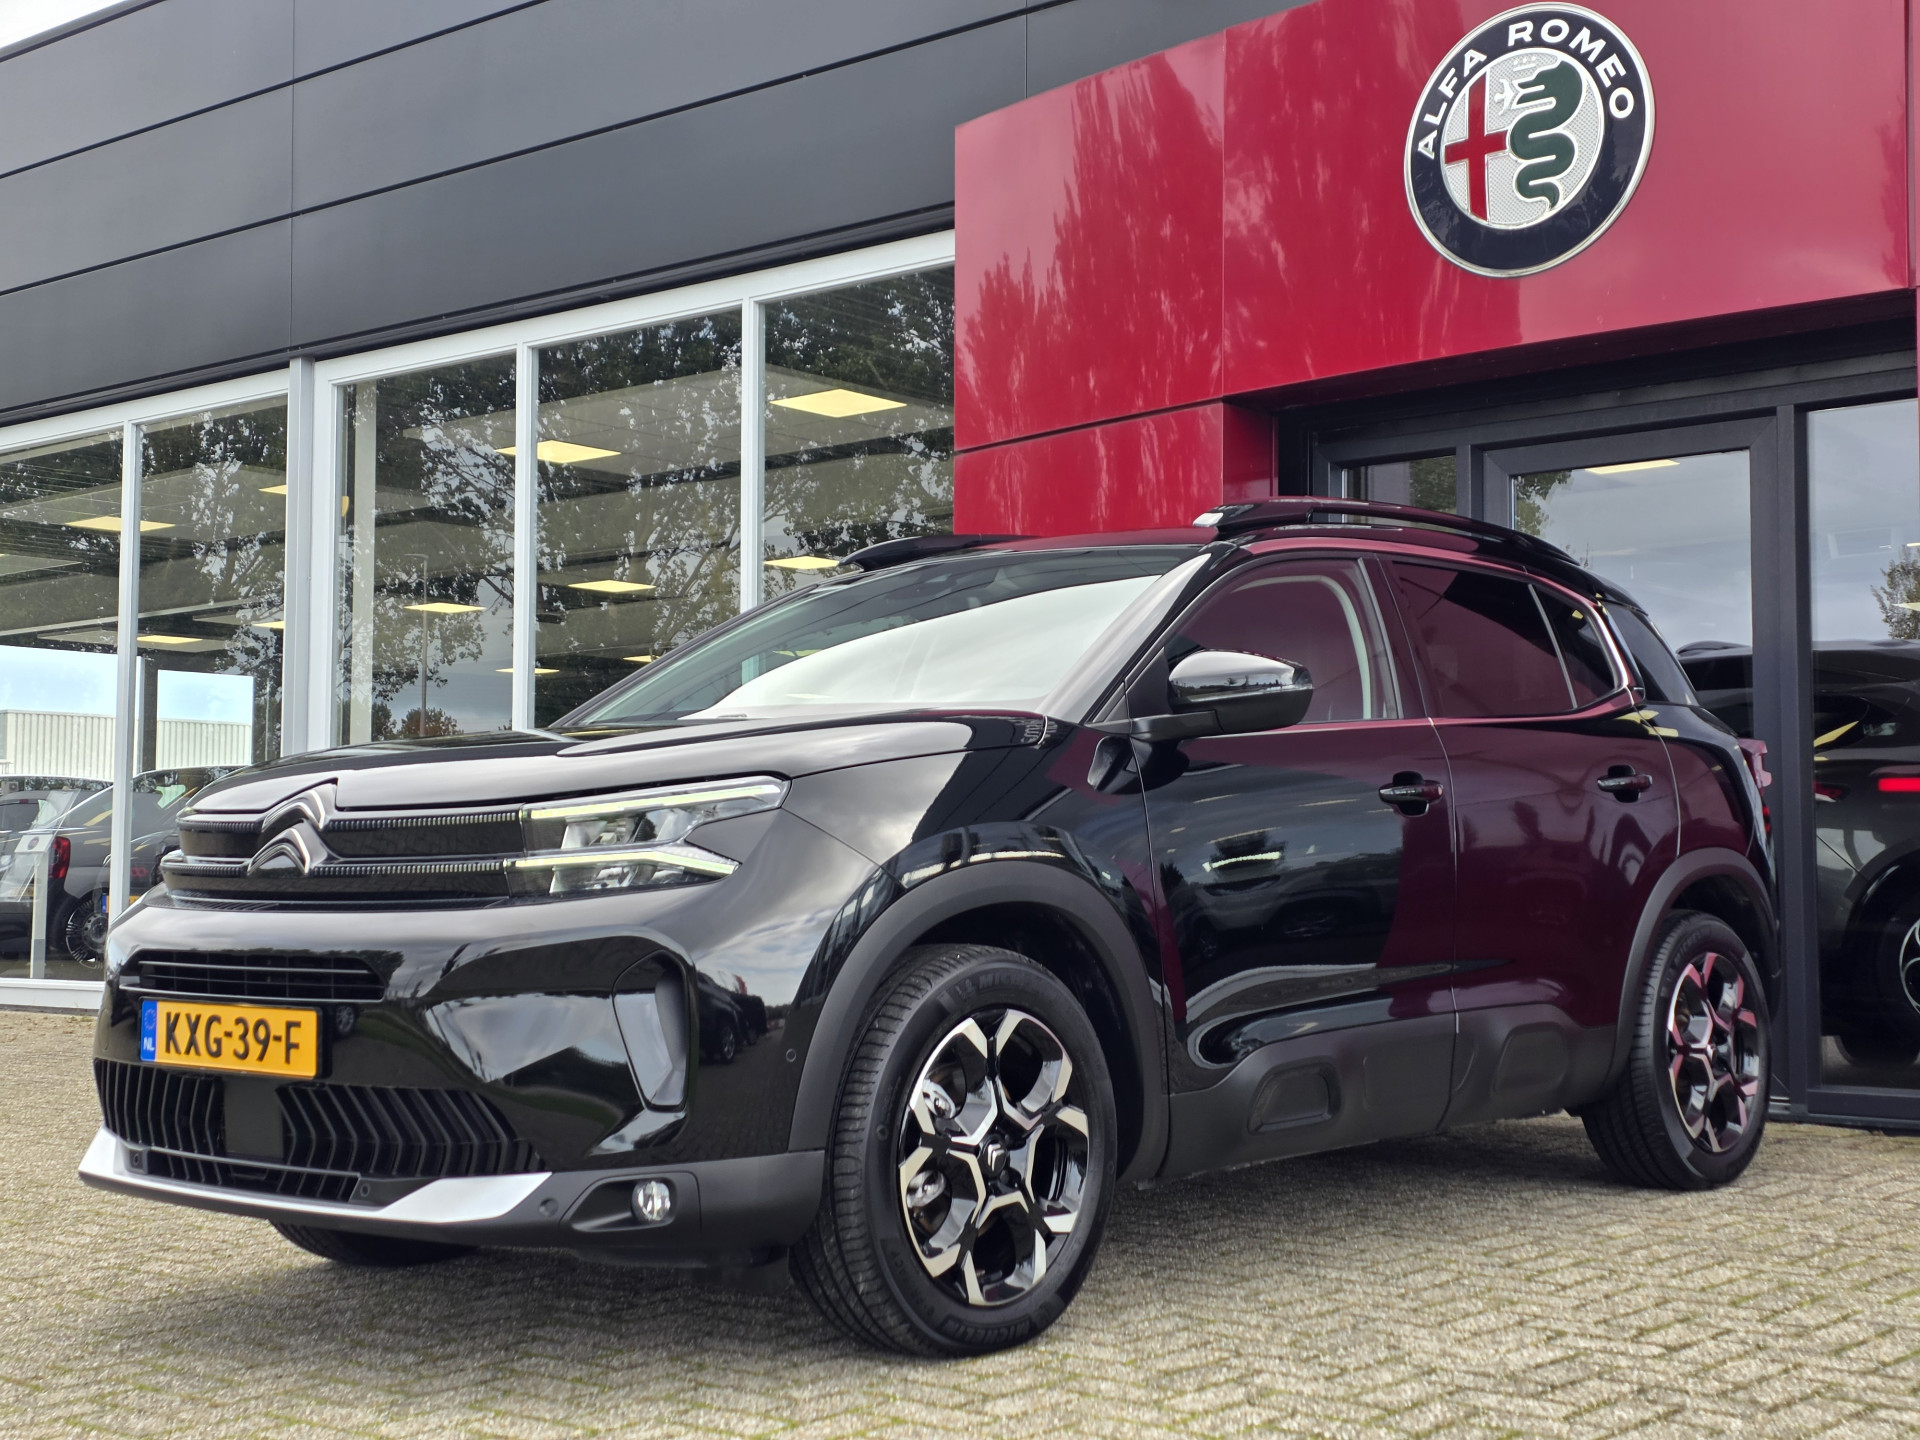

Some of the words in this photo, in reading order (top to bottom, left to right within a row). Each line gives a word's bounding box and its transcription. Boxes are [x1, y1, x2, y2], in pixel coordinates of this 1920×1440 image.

[1417, 48, 1487, 160] ALFA
[1507, 18, 1635, 119] ROMEO
[143, 1037, 155, 1052] NL
[165, 1011, 302, 1065] KXG-39-F
